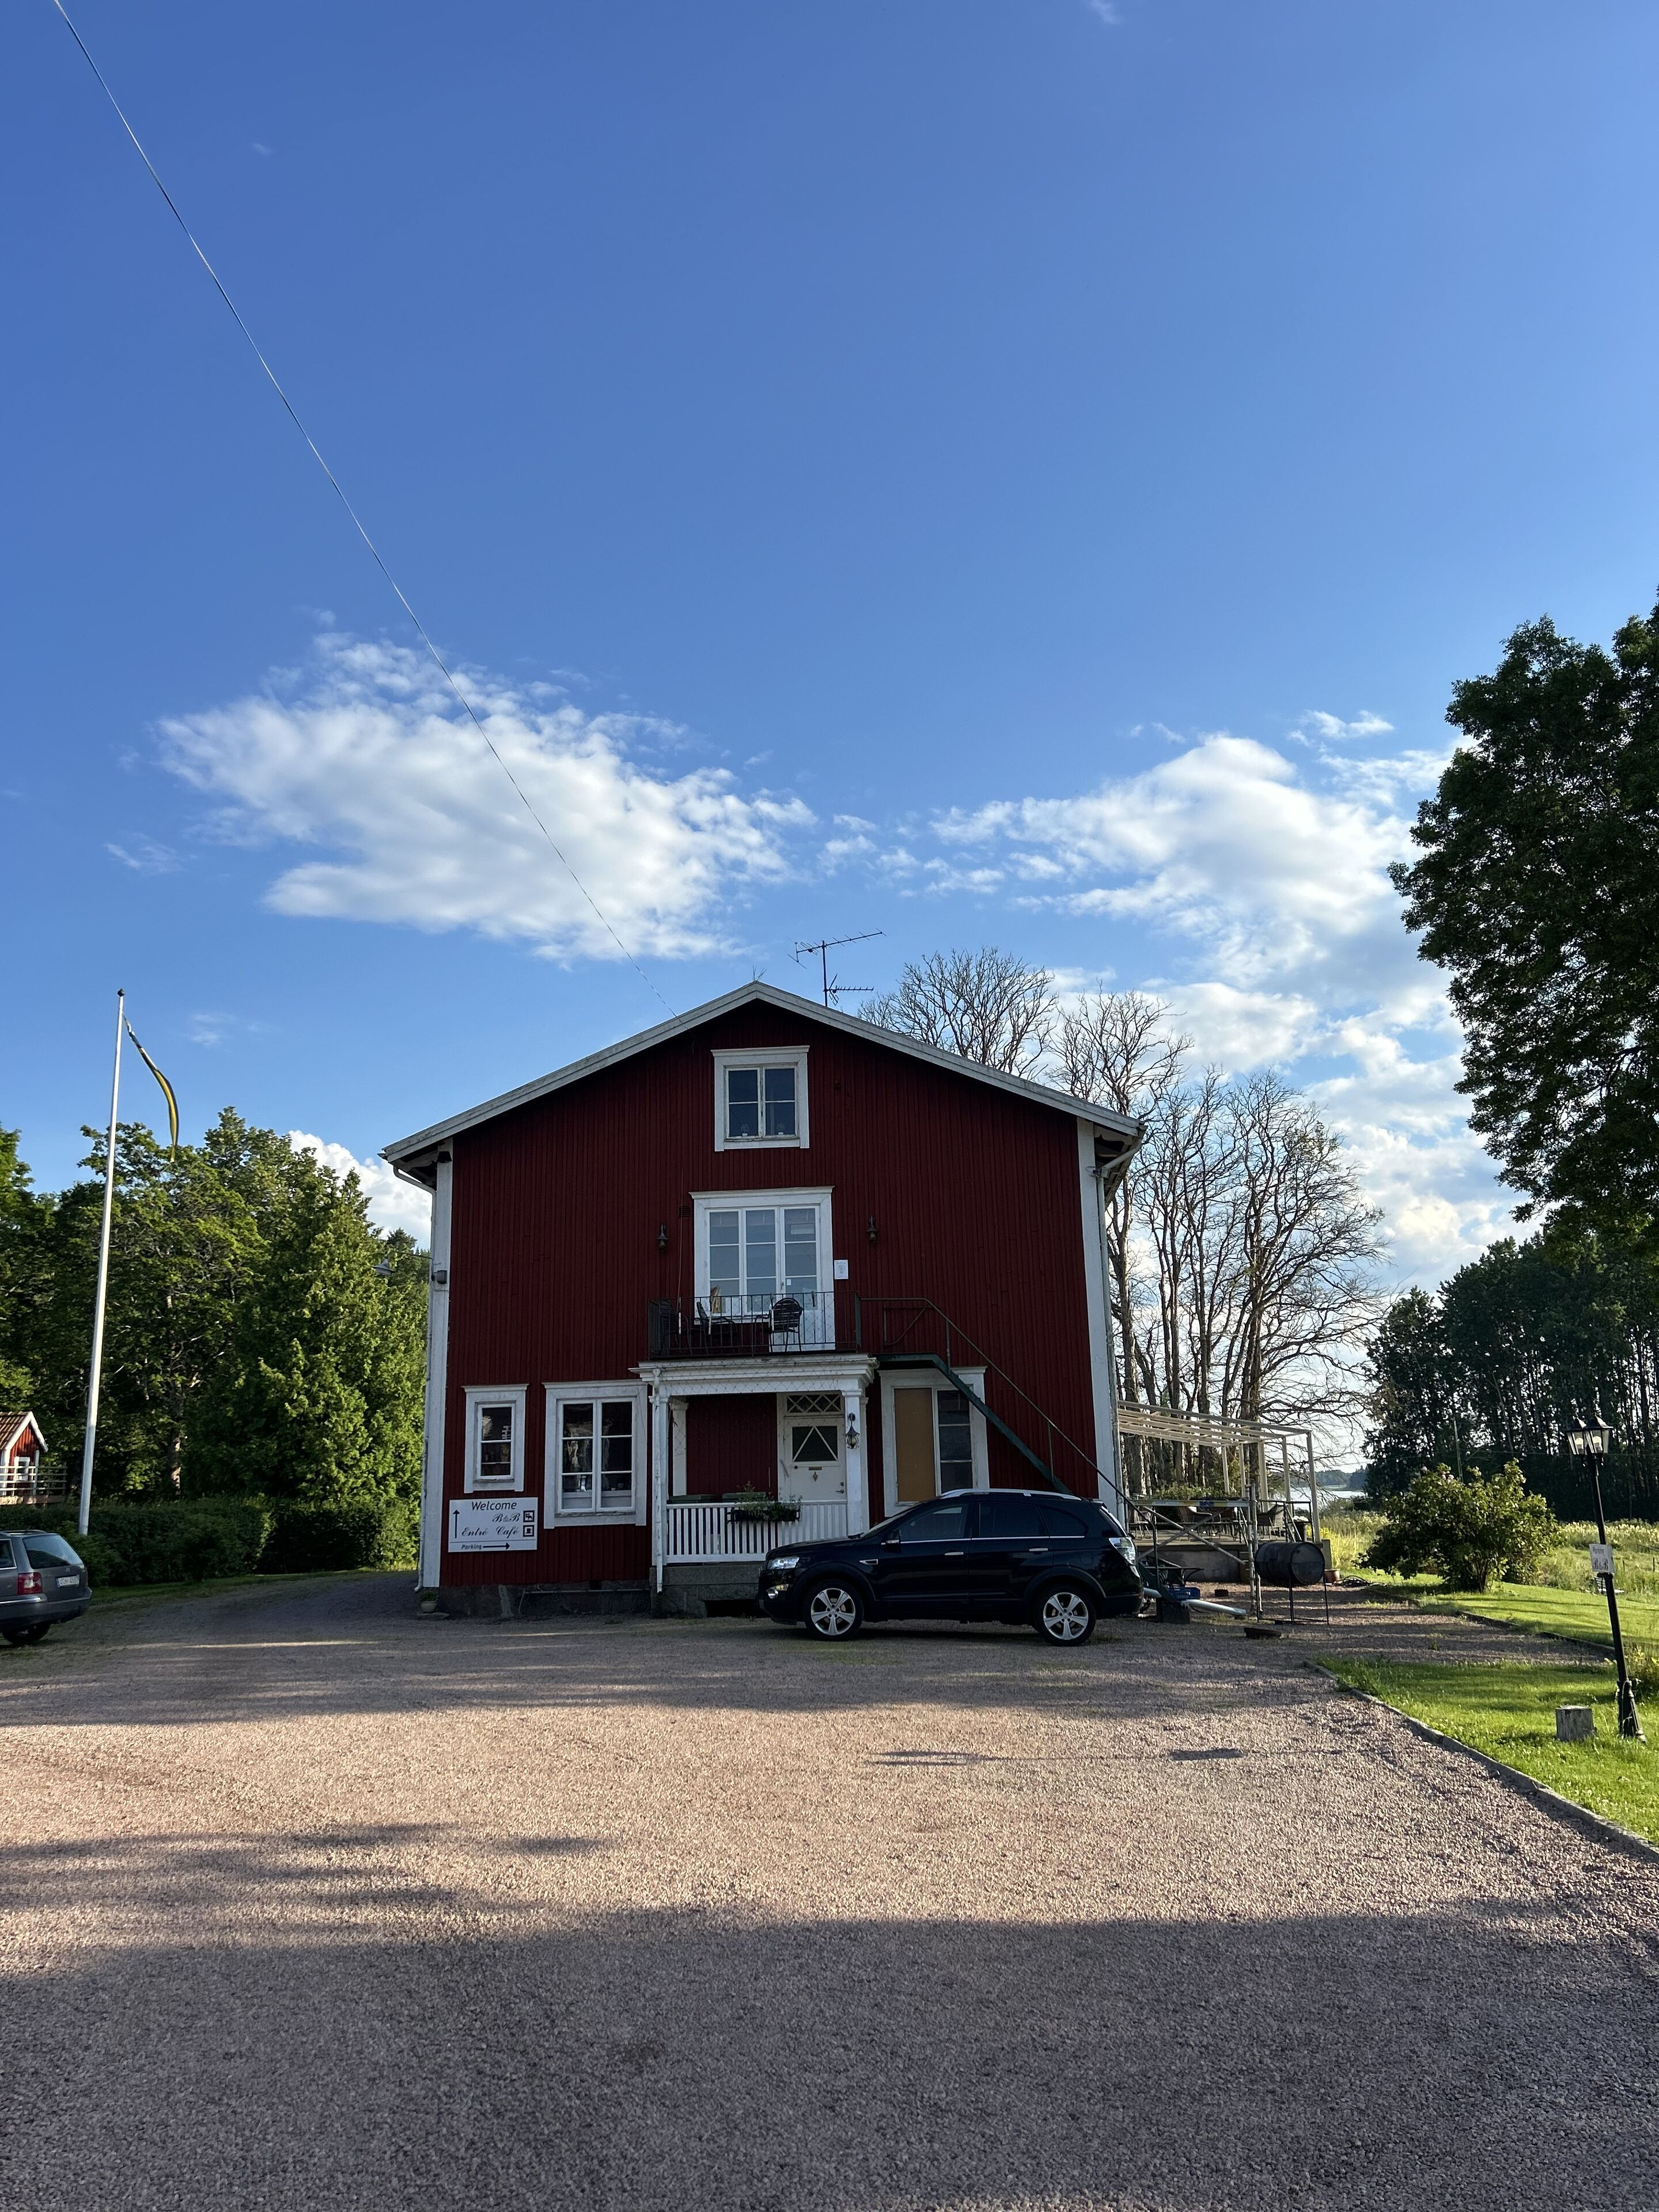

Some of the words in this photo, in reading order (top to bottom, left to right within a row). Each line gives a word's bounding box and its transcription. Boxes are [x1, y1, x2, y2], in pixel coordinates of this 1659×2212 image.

[472, 1501, 517, 1510] Welcome
[492, 1513, 520, 1522] B&B
[496, 1526, 519, 1539] Café
